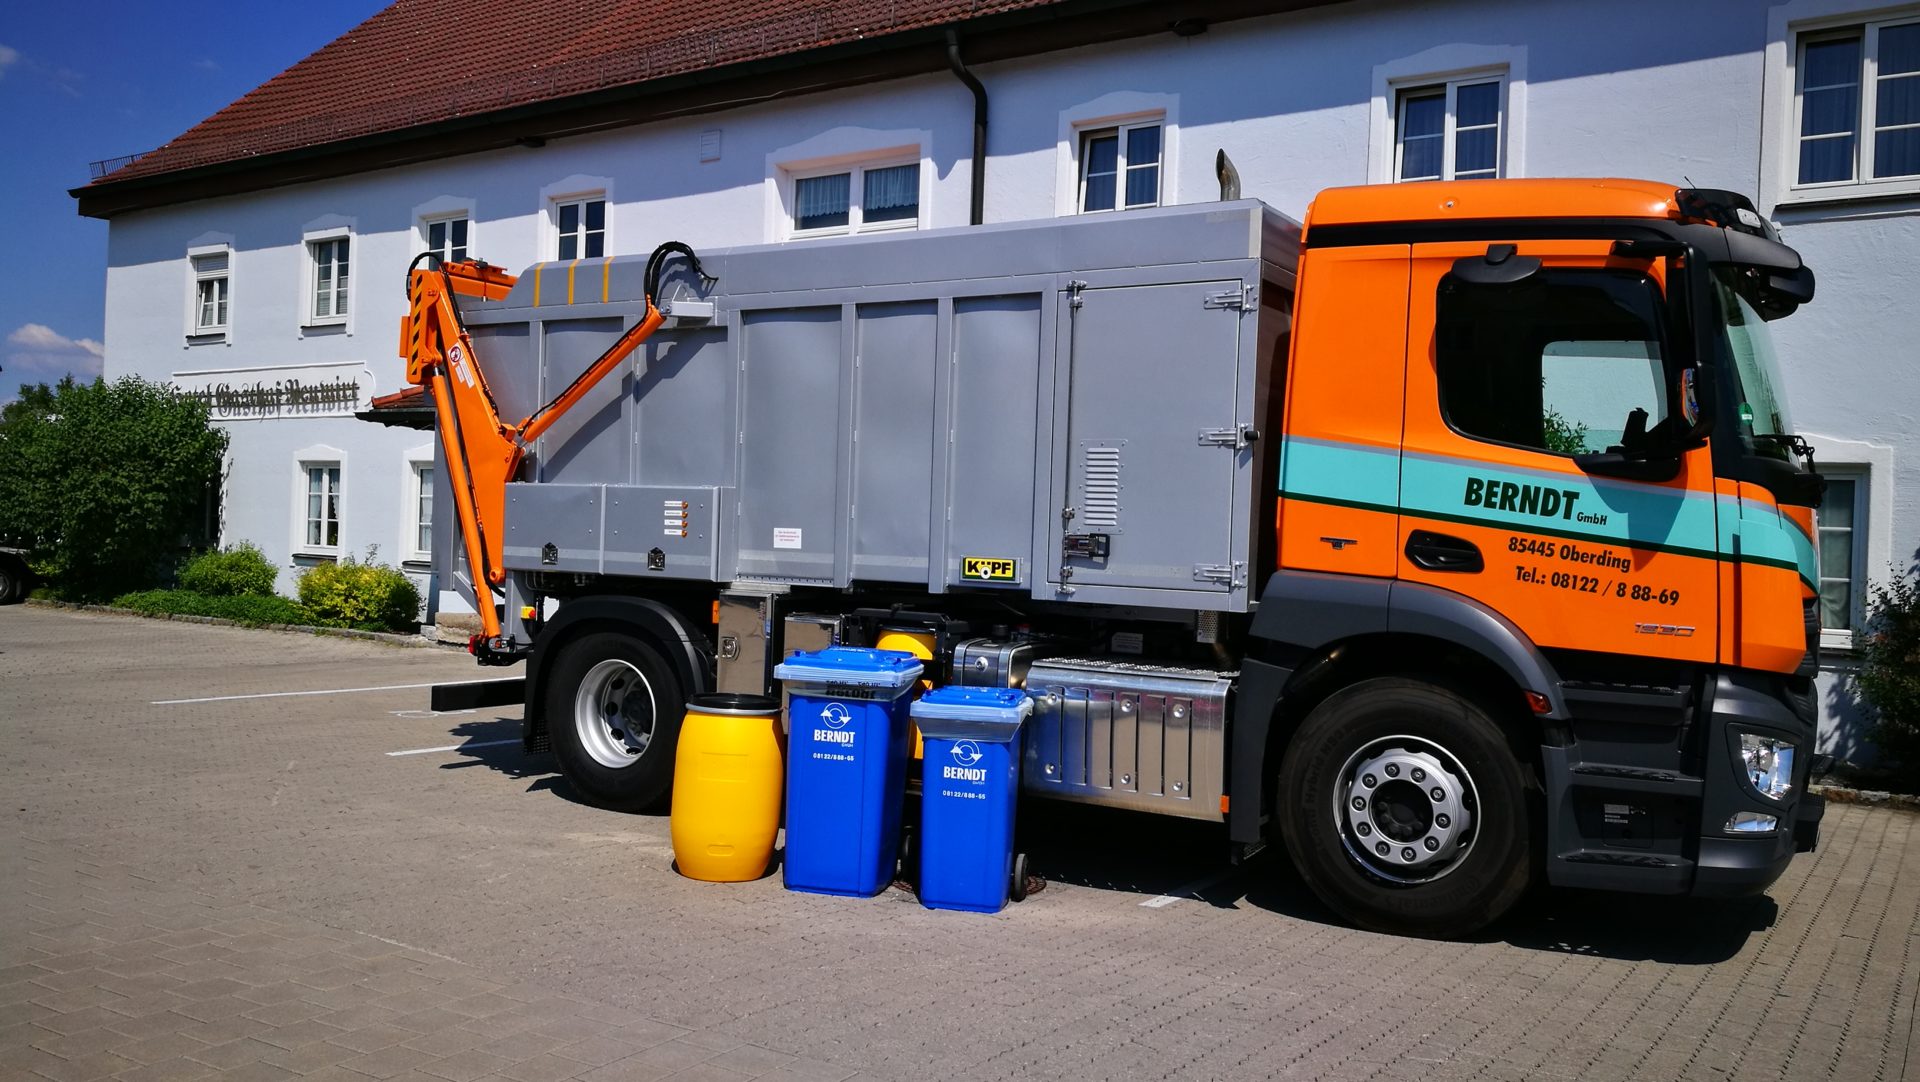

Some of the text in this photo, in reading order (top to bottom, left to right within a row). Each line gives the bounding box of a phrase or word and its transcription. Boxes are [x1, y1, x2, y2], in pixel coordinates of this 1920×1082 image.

[216, 381, 283, 412] Gasthof
[1464, 477, 1580, 520] BERNDT
[1576, 511, 1608, 526] GmbH
[1508, 536, 1631, 573] 85445 Oberding
[1515, 565, 1680, 606] Tel.: 08122 / 8 88-69
[814, 729, 856, 744] BERNDT
[943, 766, 988, 781] BERNDT
